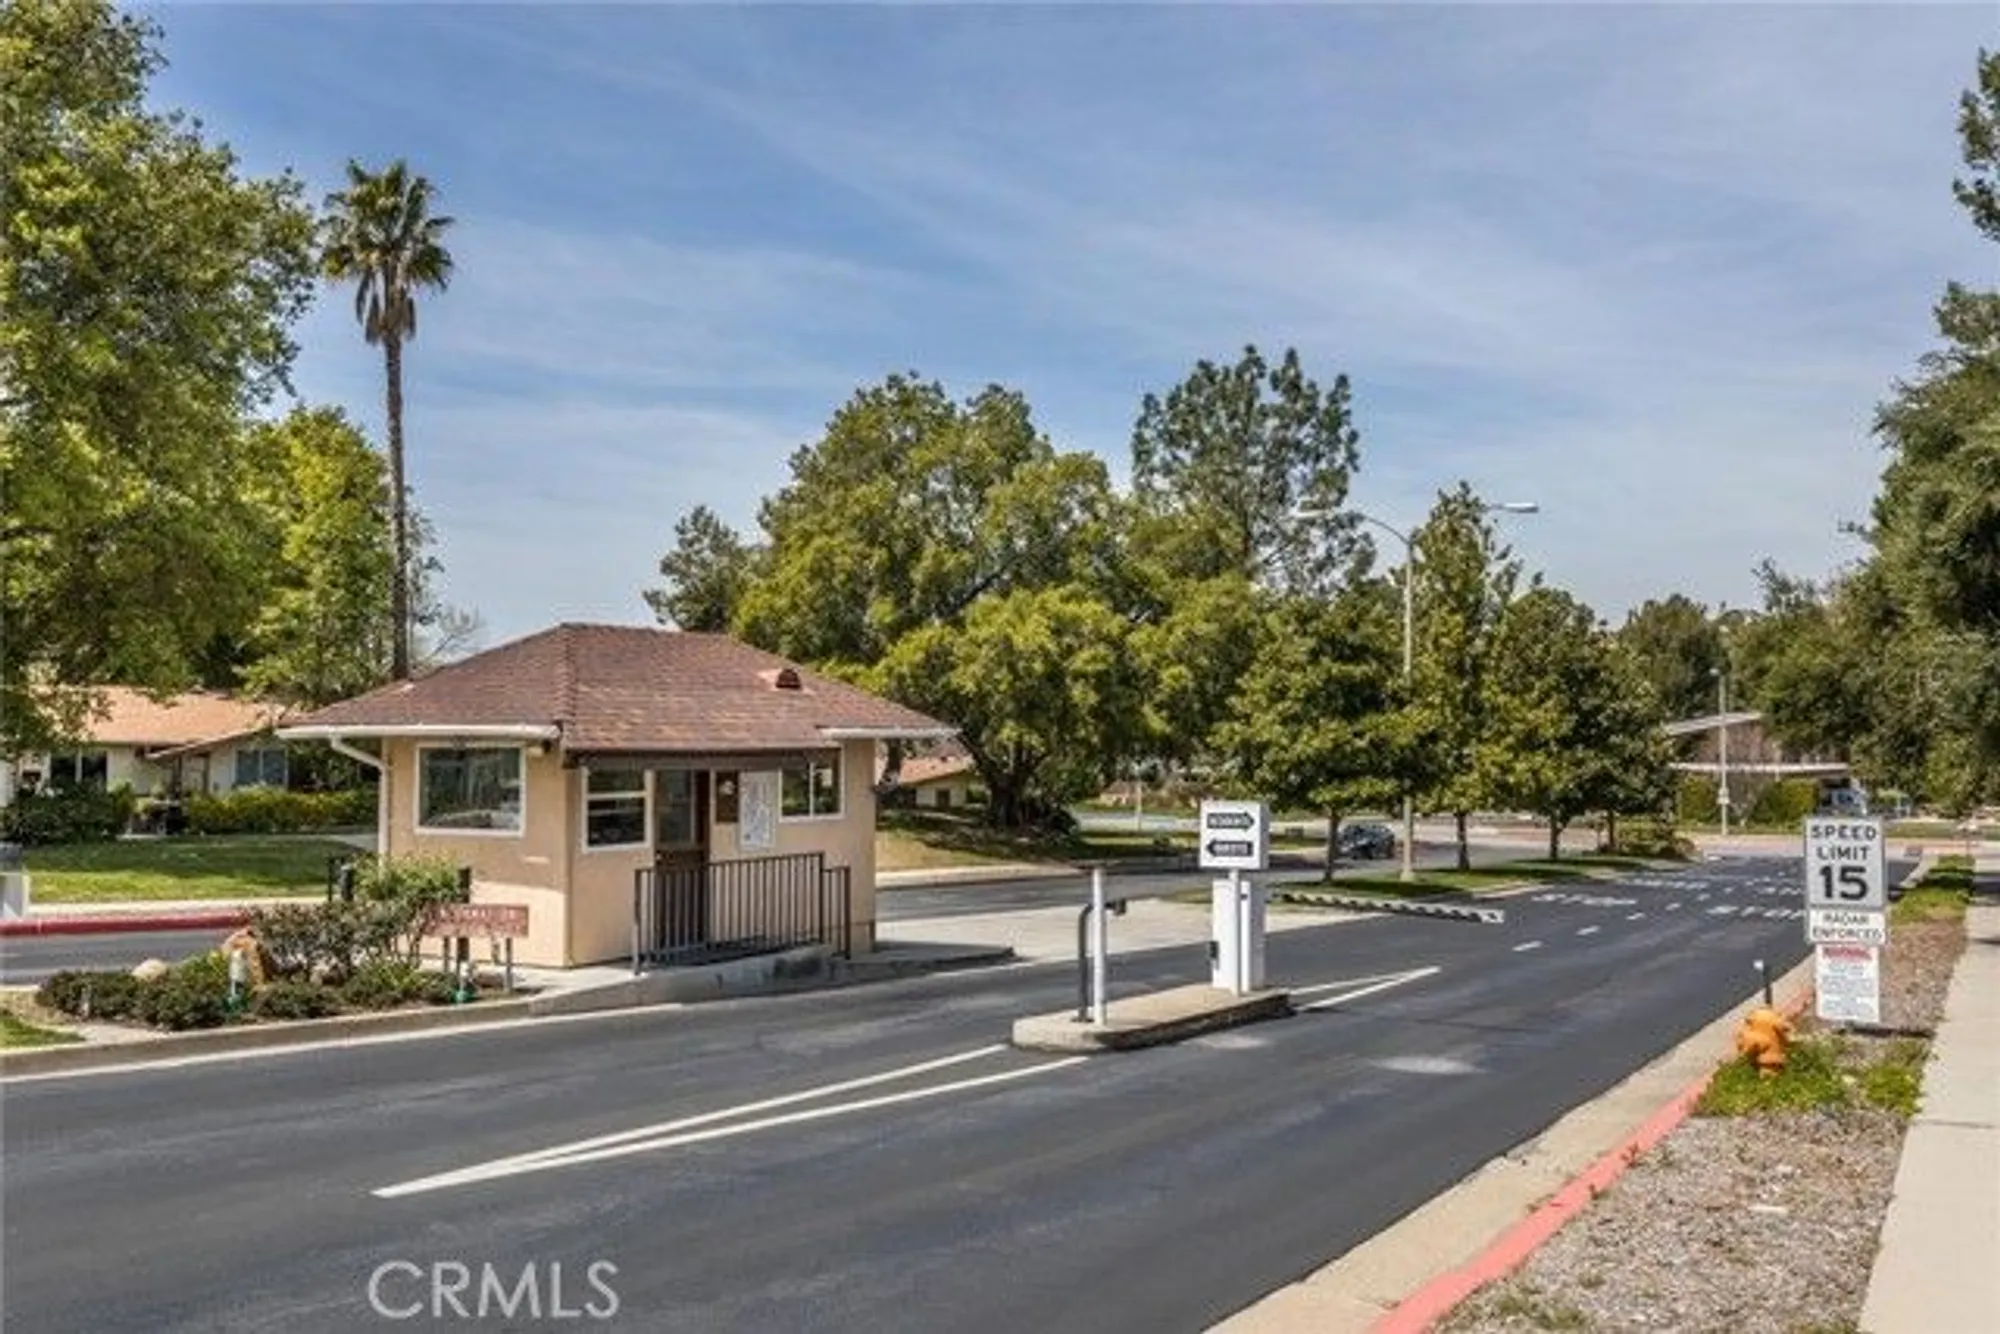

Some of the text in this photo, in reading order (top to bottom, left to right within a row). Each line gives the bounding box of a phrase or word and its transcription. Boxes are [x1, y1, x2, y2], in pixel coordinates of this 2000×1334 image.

[1811, 824, 1877, 841] SPEED
[1816, 845, 1871, 861] LIMIT
[1819, 865, 1869, 900] 15
